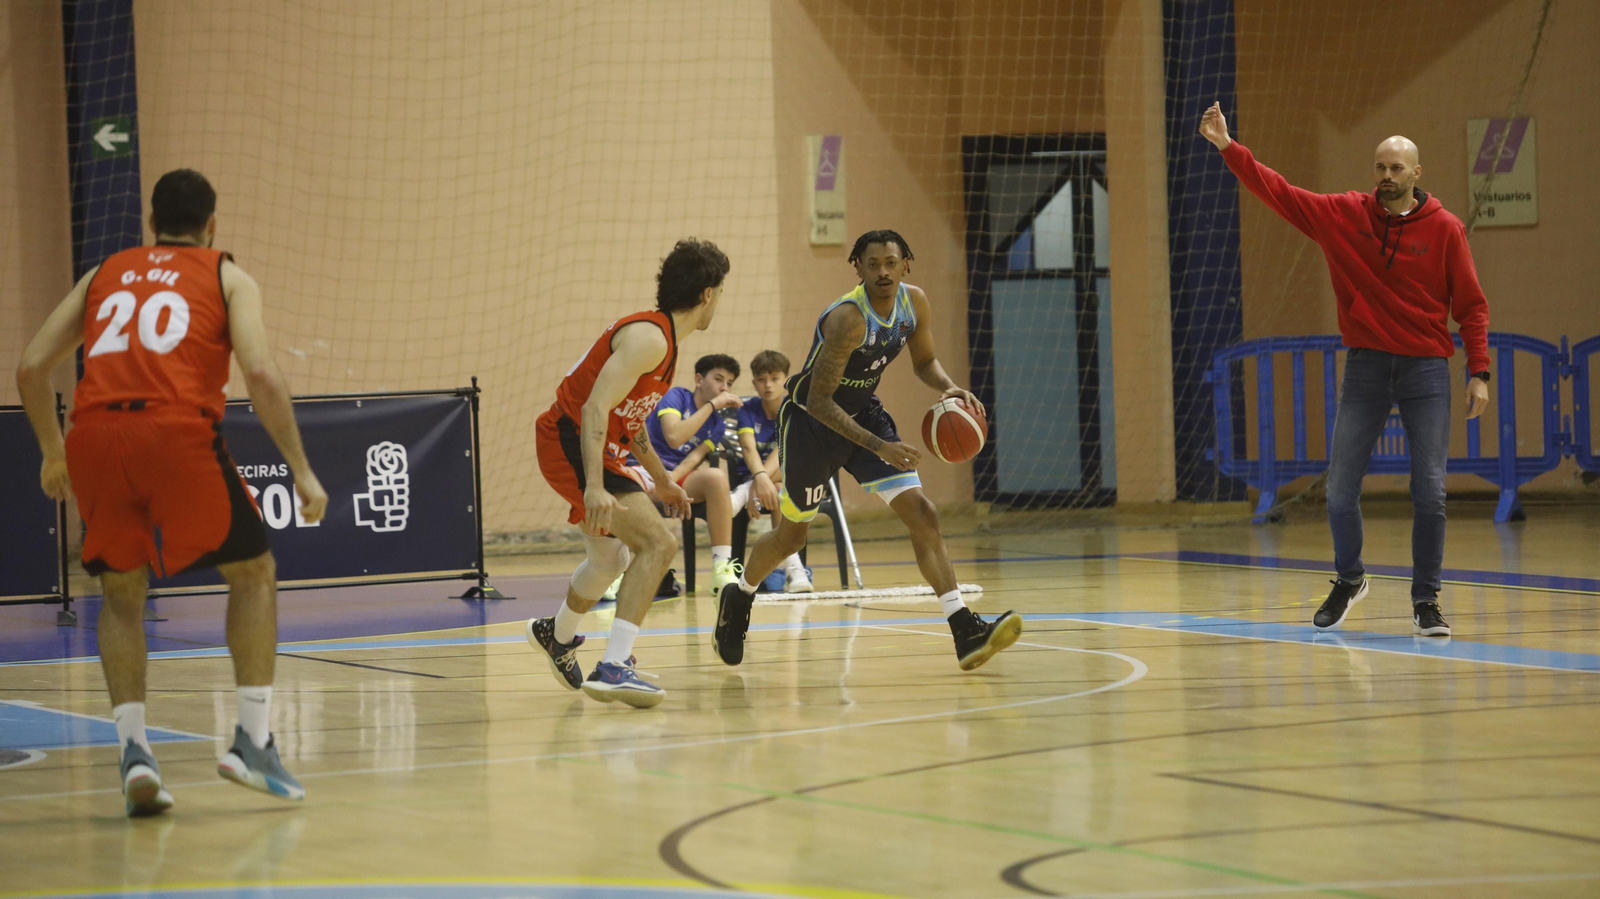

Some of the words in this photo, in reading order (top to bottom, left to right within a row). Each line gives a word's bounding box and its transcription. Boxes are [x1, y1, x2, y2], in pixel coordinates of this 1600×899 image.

[121, 270, 142, 286] G.
[147, 268, 180, 287] GIL
[88, 290, 190, 358] 20
[805, 484, 824, 506] 10
